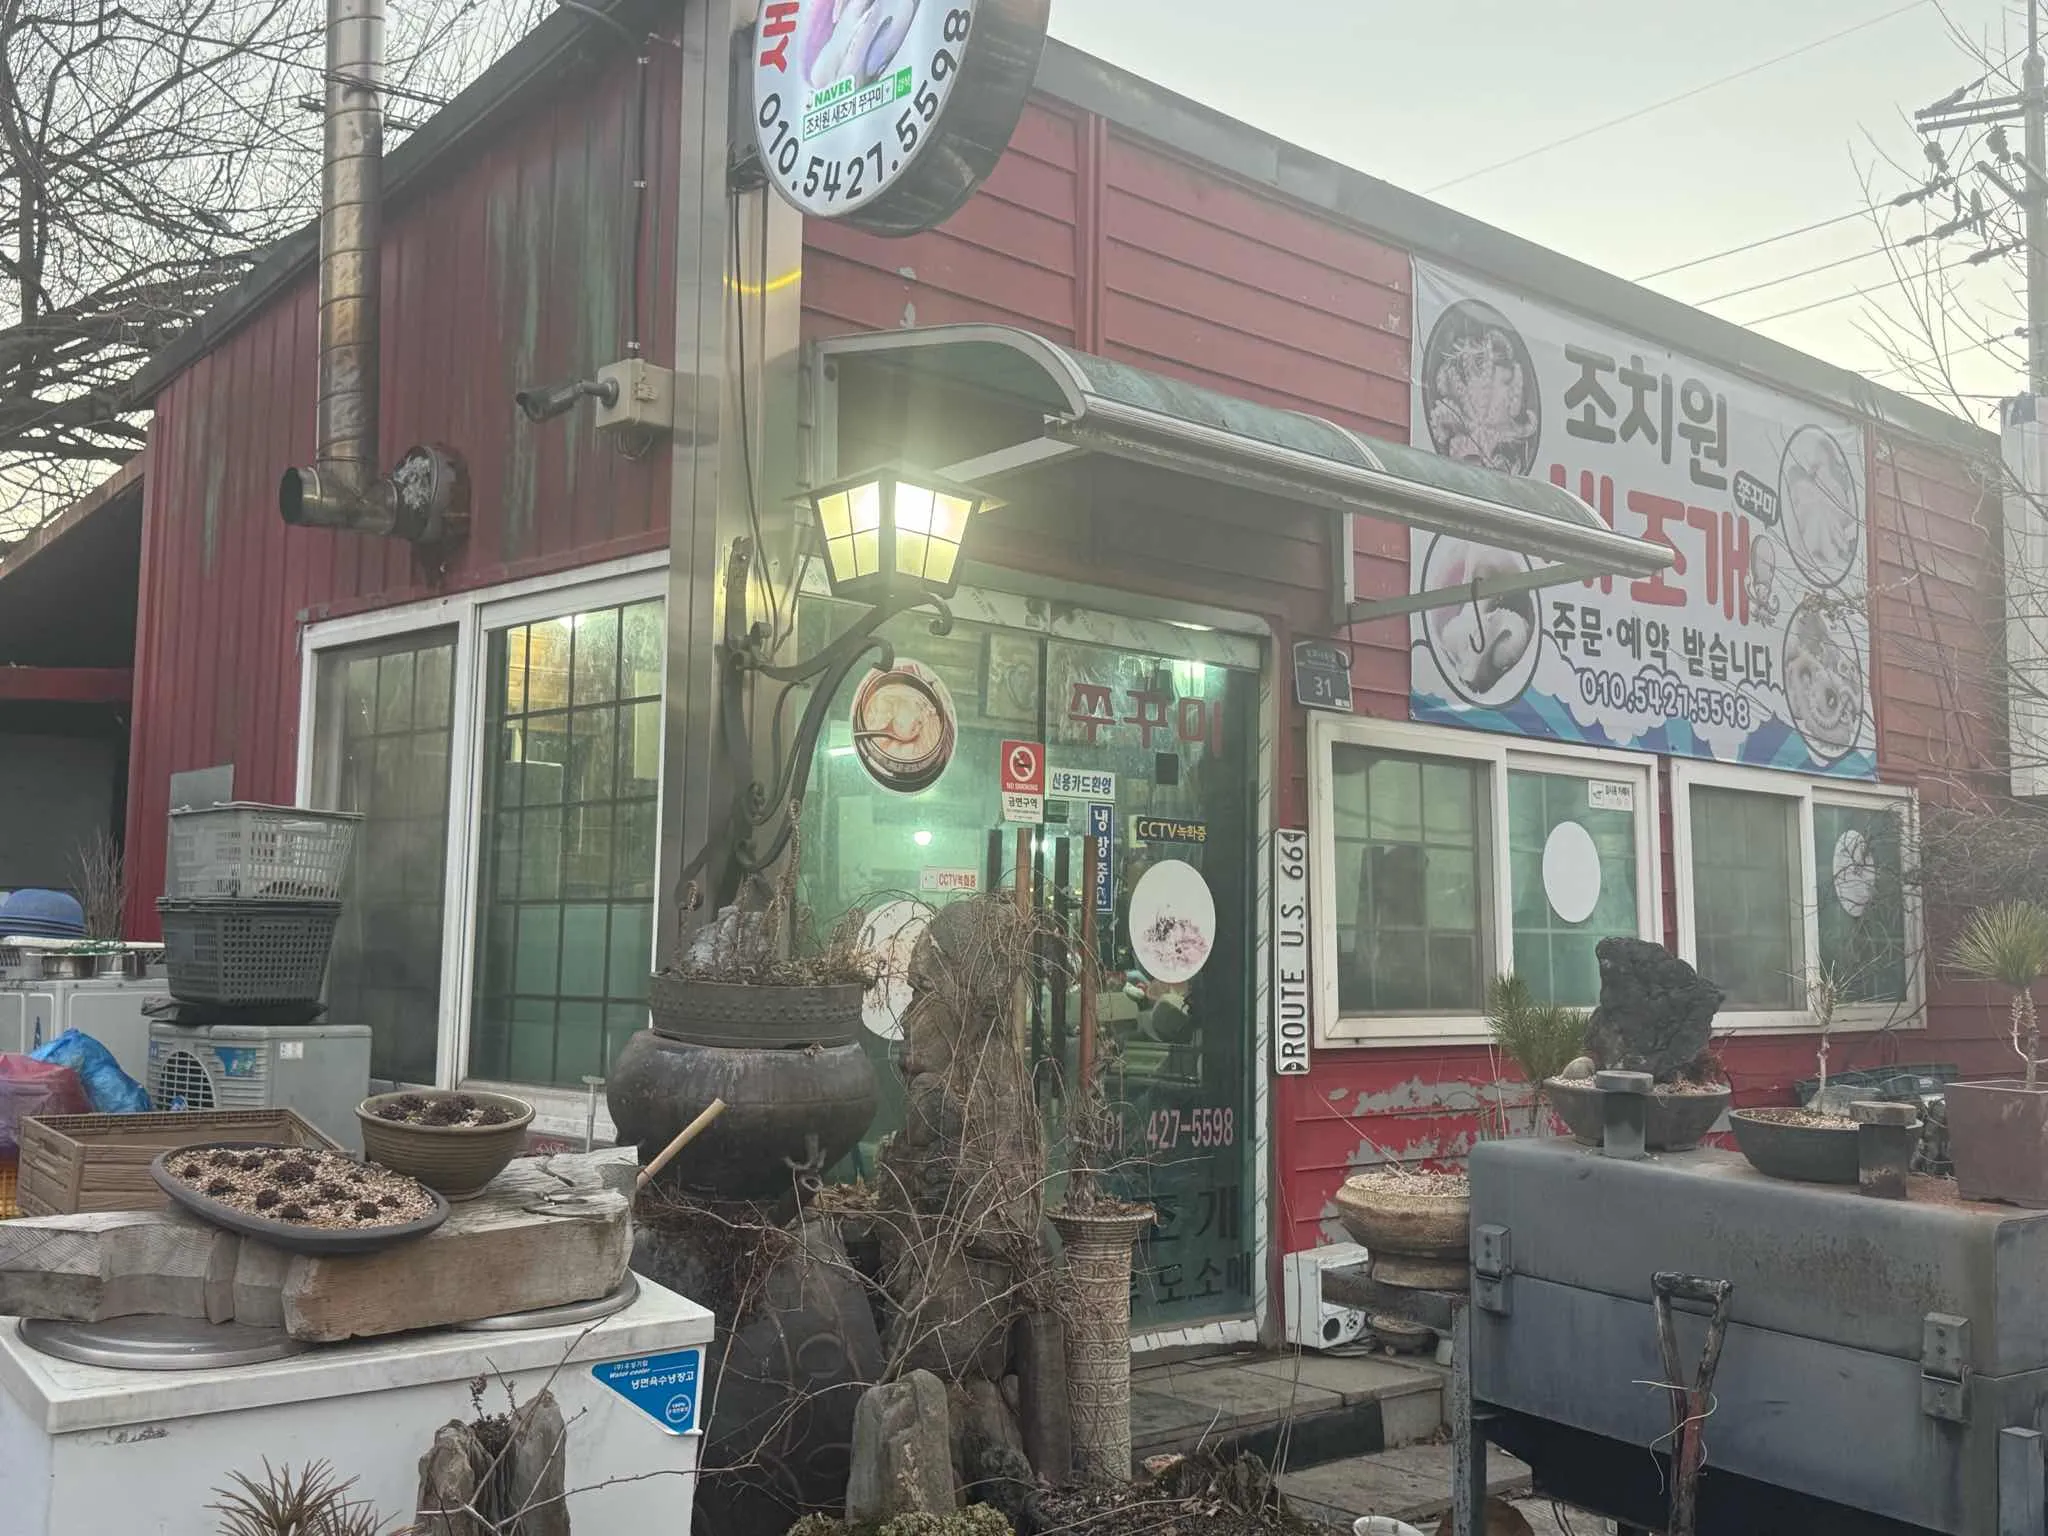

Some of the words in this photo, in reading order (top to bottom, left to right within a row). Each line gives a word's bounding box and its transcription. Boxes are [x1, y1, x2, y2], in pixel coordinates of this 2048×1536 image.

[759, 8, 971, 202] 010.5427.5598
[814, 78, 853, 107] NAVER
[804, 113, 831, 136] 조치원
[1564, 343, 1728, 490] 조치원
[1737, 476, 1778, 520] 쭈꾸미
[1682, 626, 1773, 682] 받습니다
[1313, 677, 1331, 697] 31
[1580, 670, 1752, 731] 010.5427.5598
[1069, 683, 1223, 757] 쭈꾸미
[1008, 796, 1038, 808] 금연구역
[1052, 773, 1112, 794] 신용카드환영
[1139, 820, 1208, 842] CCTV녹화중
[1281, 846, 1304, 880] 66
[1281, 896, 1304, 947] U.S.
[1281, 969, 1305, 1058] ROUTE
